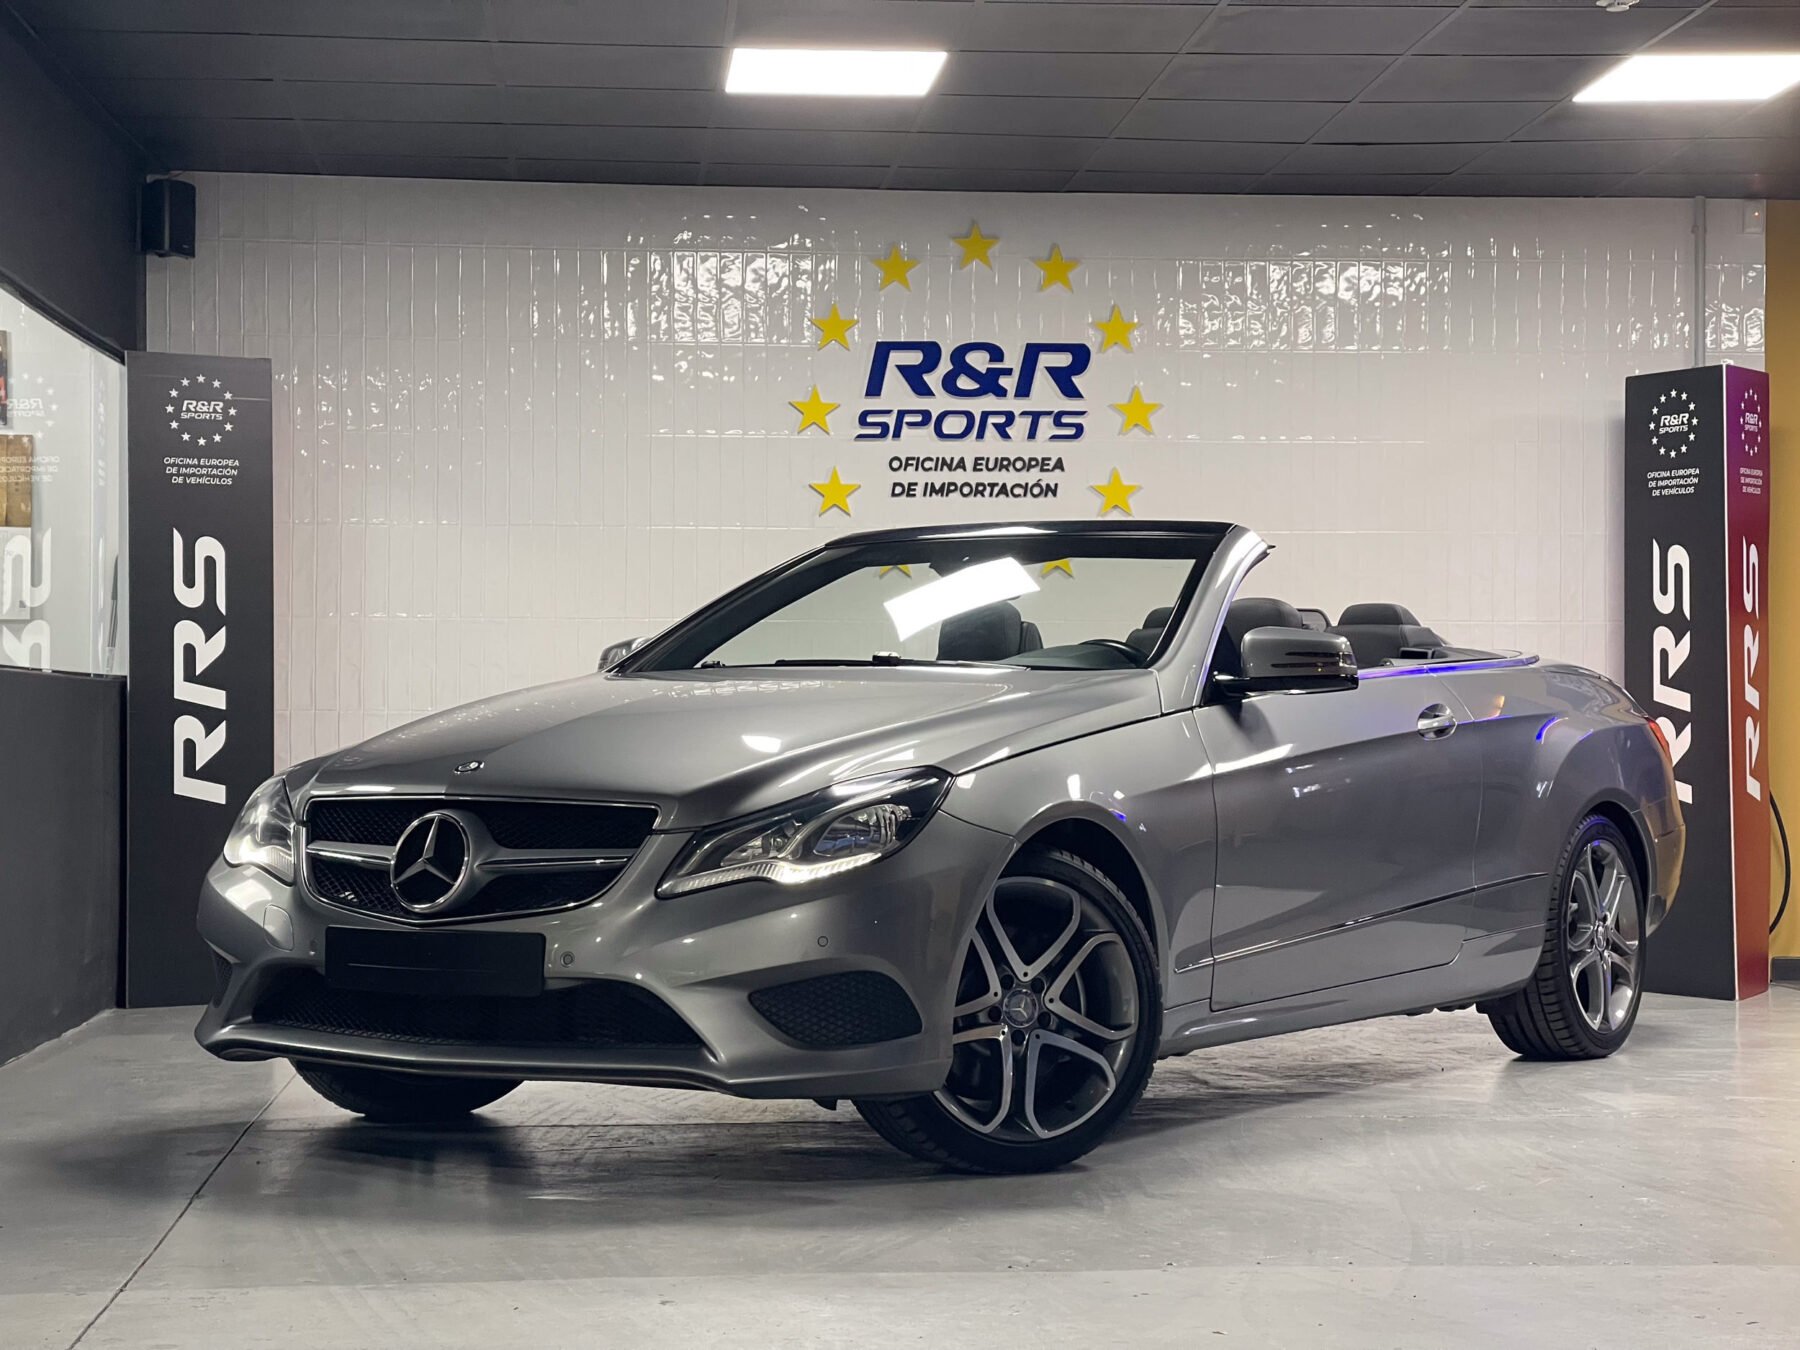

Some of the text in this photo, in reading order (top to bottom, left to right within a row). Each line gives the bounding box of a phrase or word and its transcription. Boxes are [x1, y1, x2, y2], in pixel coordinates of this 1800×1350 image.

[865, 341, 1091, 399] R&R
[182, 400, 224, 413] R&R
[180, 412, 223, 421] SPORTS
[1660, 413, 1689, 427] R&R
[854, 409, 1088, 440] SPORTS
[1658, 425, 1688, 434] SPORTS
[163, 457, 240, 467] OFICINA EUROPEA
[888, 456, 1065, 472] OFICINA EUROPEA
[165, 466, 238, 476] DE IMPORTACIÓN
[1647, 467, 1700, 479] OFICINA EUROPEA
[172, 475, 233, 485] DE VEHÍCULOS
[1648, 477, 1699, 488] DE IMPORTACIÓN
[891, 479, 1058, 498] DE IMPORTACIÓN
[1661, 486, 1694, 496] VEHÍCULOS
[173, 527, 226, 804] RRS
[1653, 538, 1692, 804] RRS
[1743, 535, 1760, 801] RRS
